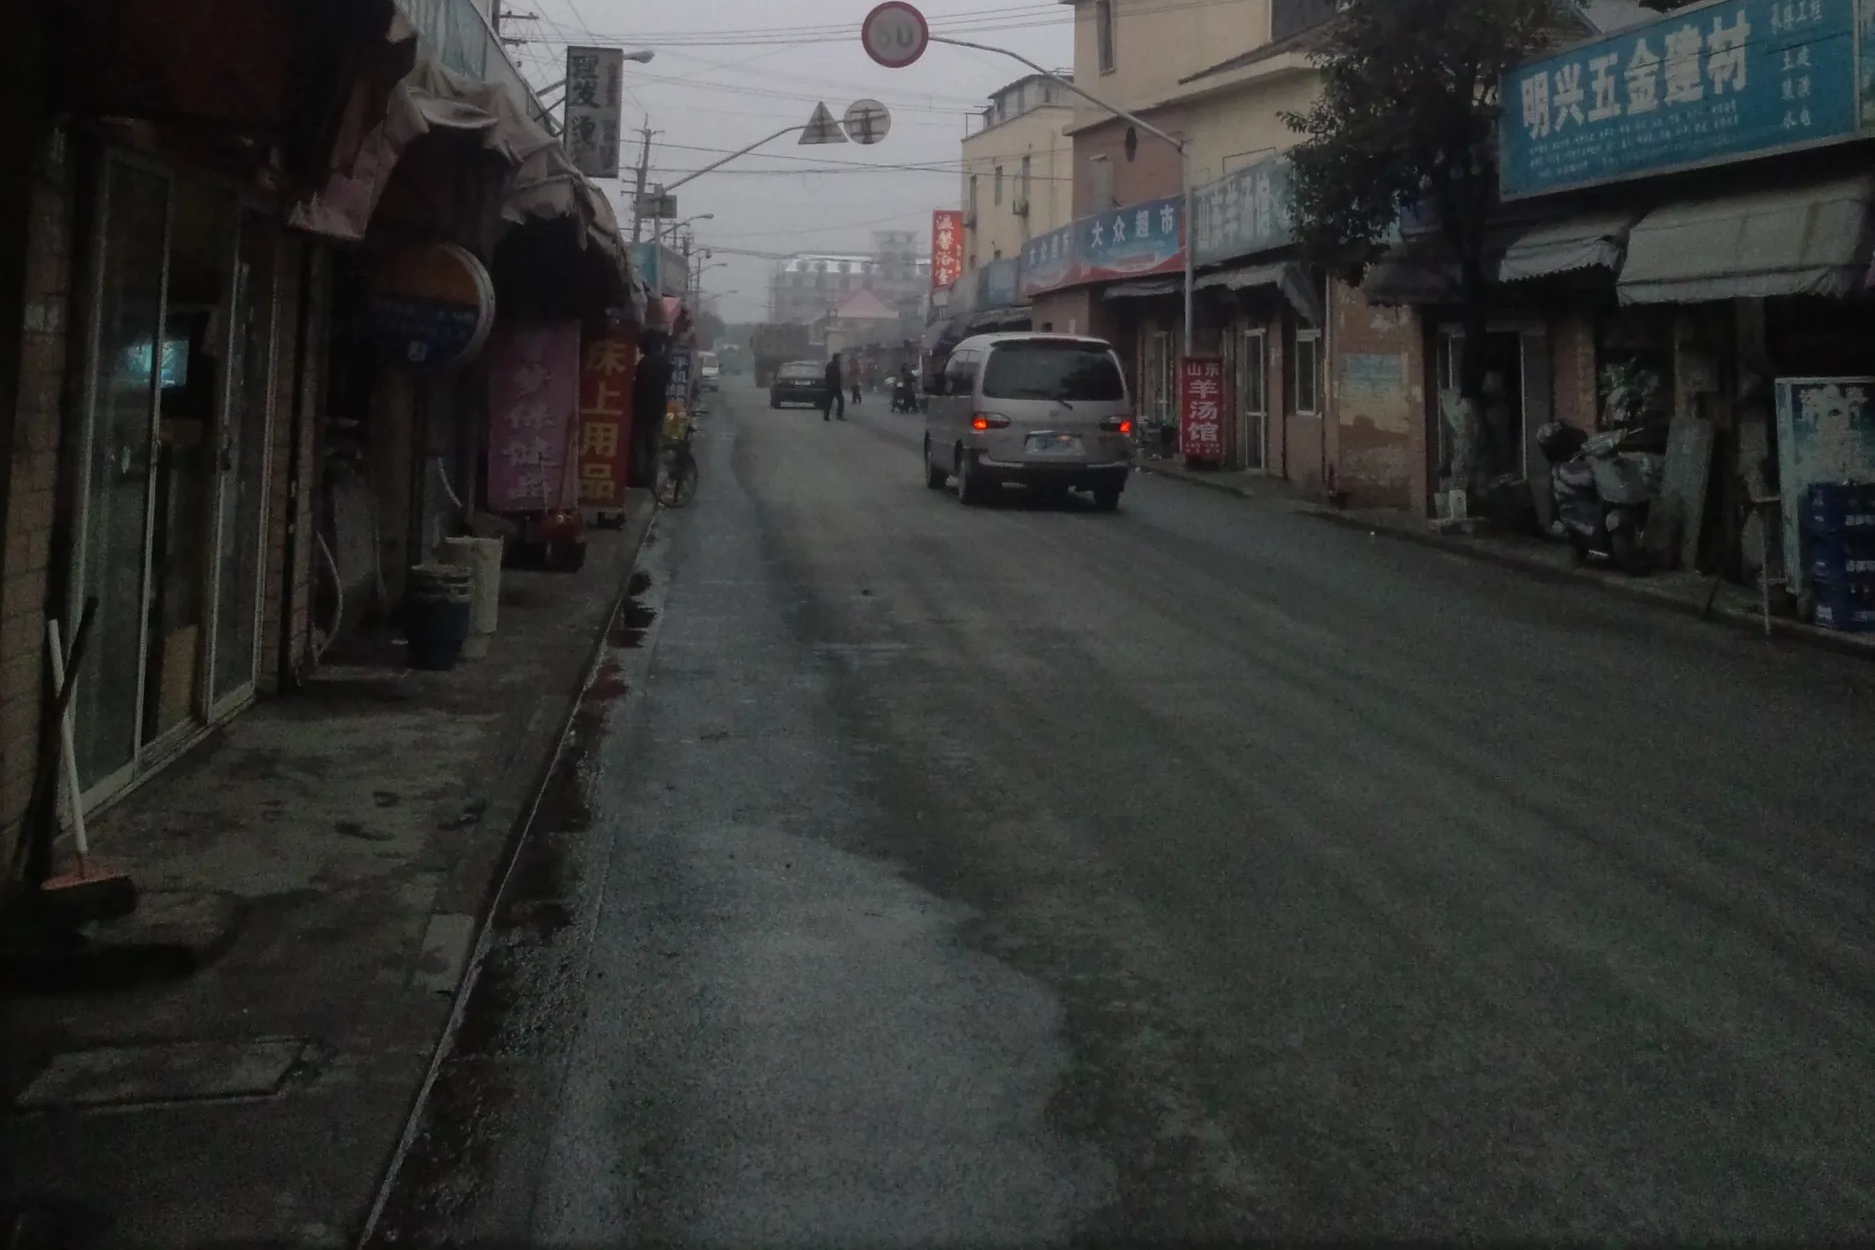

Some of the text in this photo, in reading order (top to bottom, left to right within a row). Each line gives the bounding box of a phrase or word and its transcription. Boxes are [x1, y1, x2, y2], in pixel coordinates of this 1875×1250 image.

[1520, 9, 1751, 140] 明兴五金建材
[935, 213, 955, 285] 温馨浴室
[1091, 203, 1177, 249] 大众超市
[1186, 362, 1220, 379] 山东
[578, 338, 627, 500] 床上用品
[1186, 379, 1220, 443] 羊汤馆
